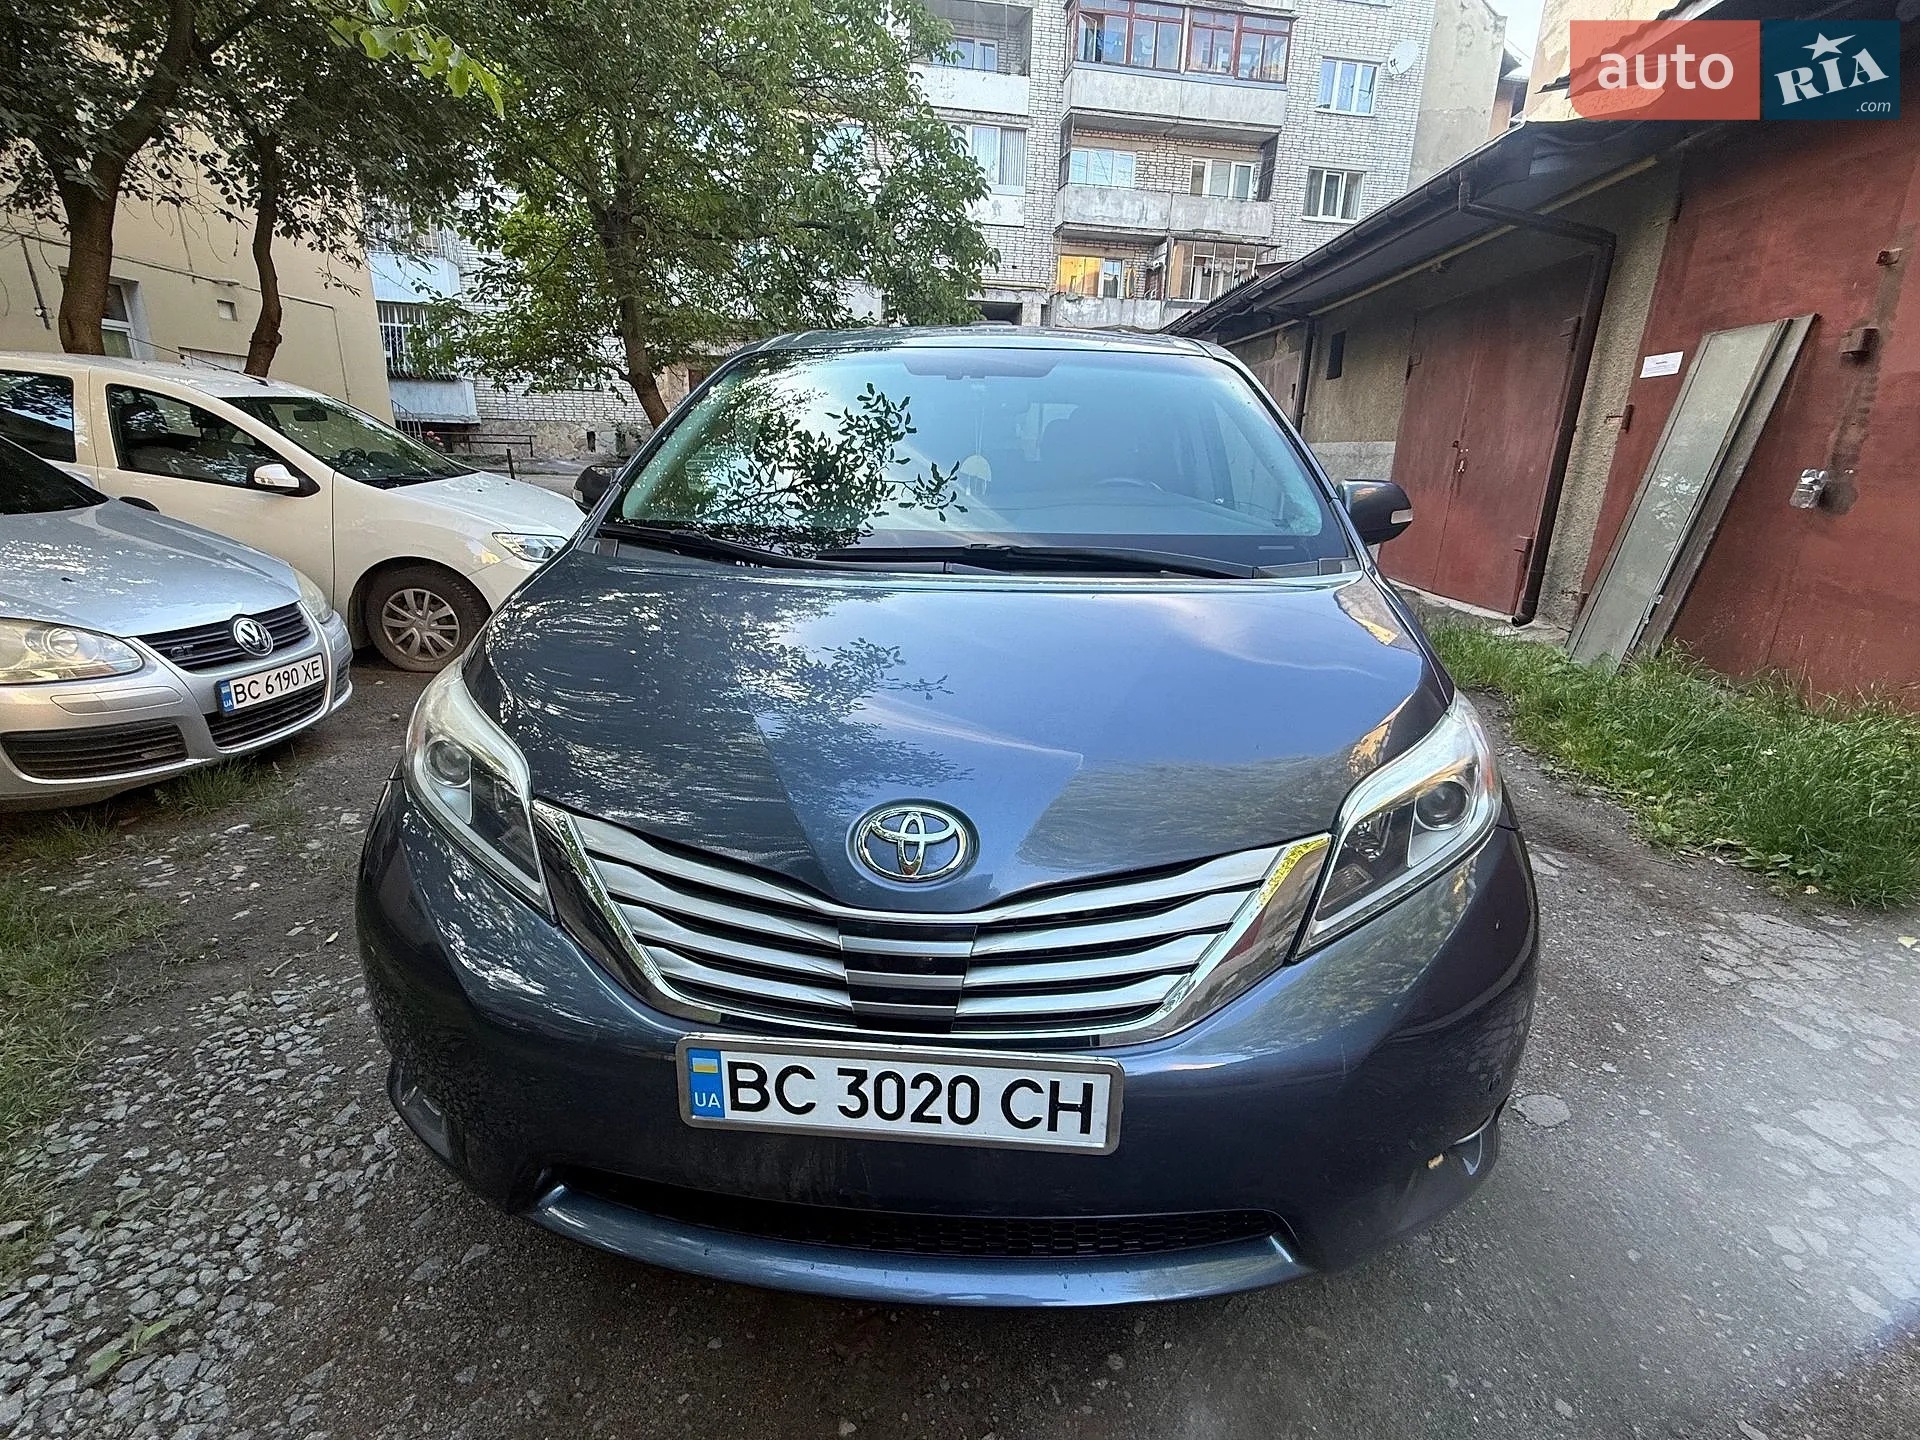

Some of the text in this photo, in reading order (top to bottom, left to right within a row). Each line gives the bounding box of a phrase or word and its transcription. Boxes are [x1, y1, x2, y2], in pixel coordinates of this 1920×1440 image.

[233, 660, 321, 705] BC 6190 XE
[223, 700, 233, 708] UA
[694, 1091, 721, 1109] UA
[727, 1060, 1095, 1135] BC 3020 CH
